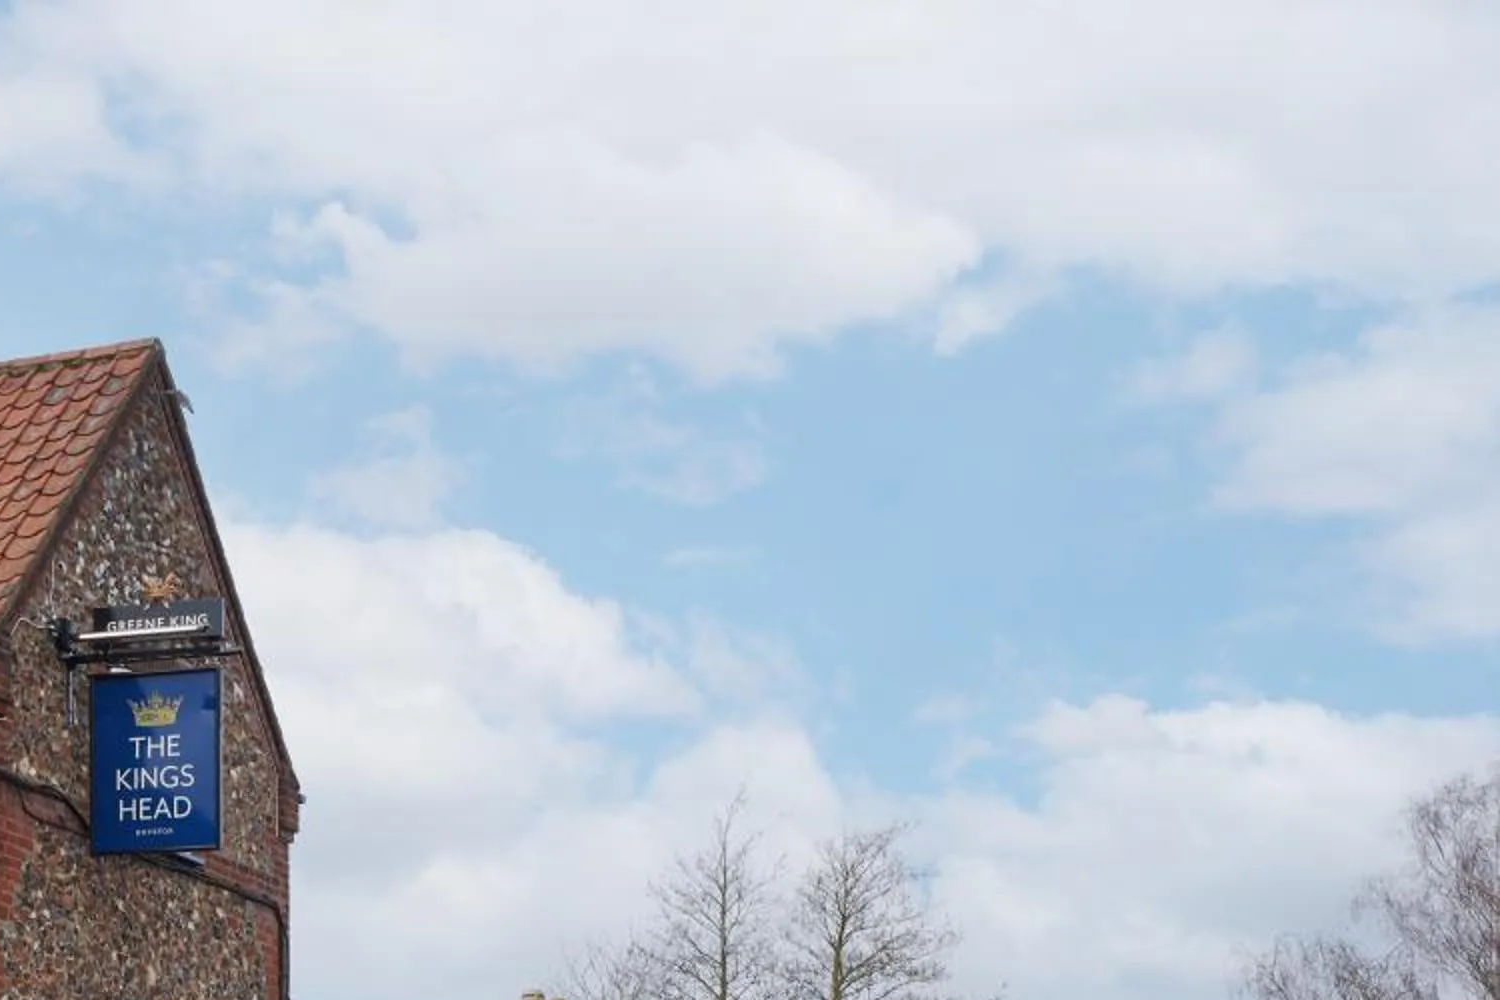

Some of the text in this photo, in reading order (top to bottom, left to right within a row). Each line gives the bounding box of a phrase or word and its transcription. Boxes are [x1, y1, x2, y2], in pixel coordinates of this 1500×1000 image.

[169, 613, 209, 627] KING
[128, 734, 181, 759] THE
[115, 763, 195, 791] KINGS
[119, 795, 193, 822] HEAD
